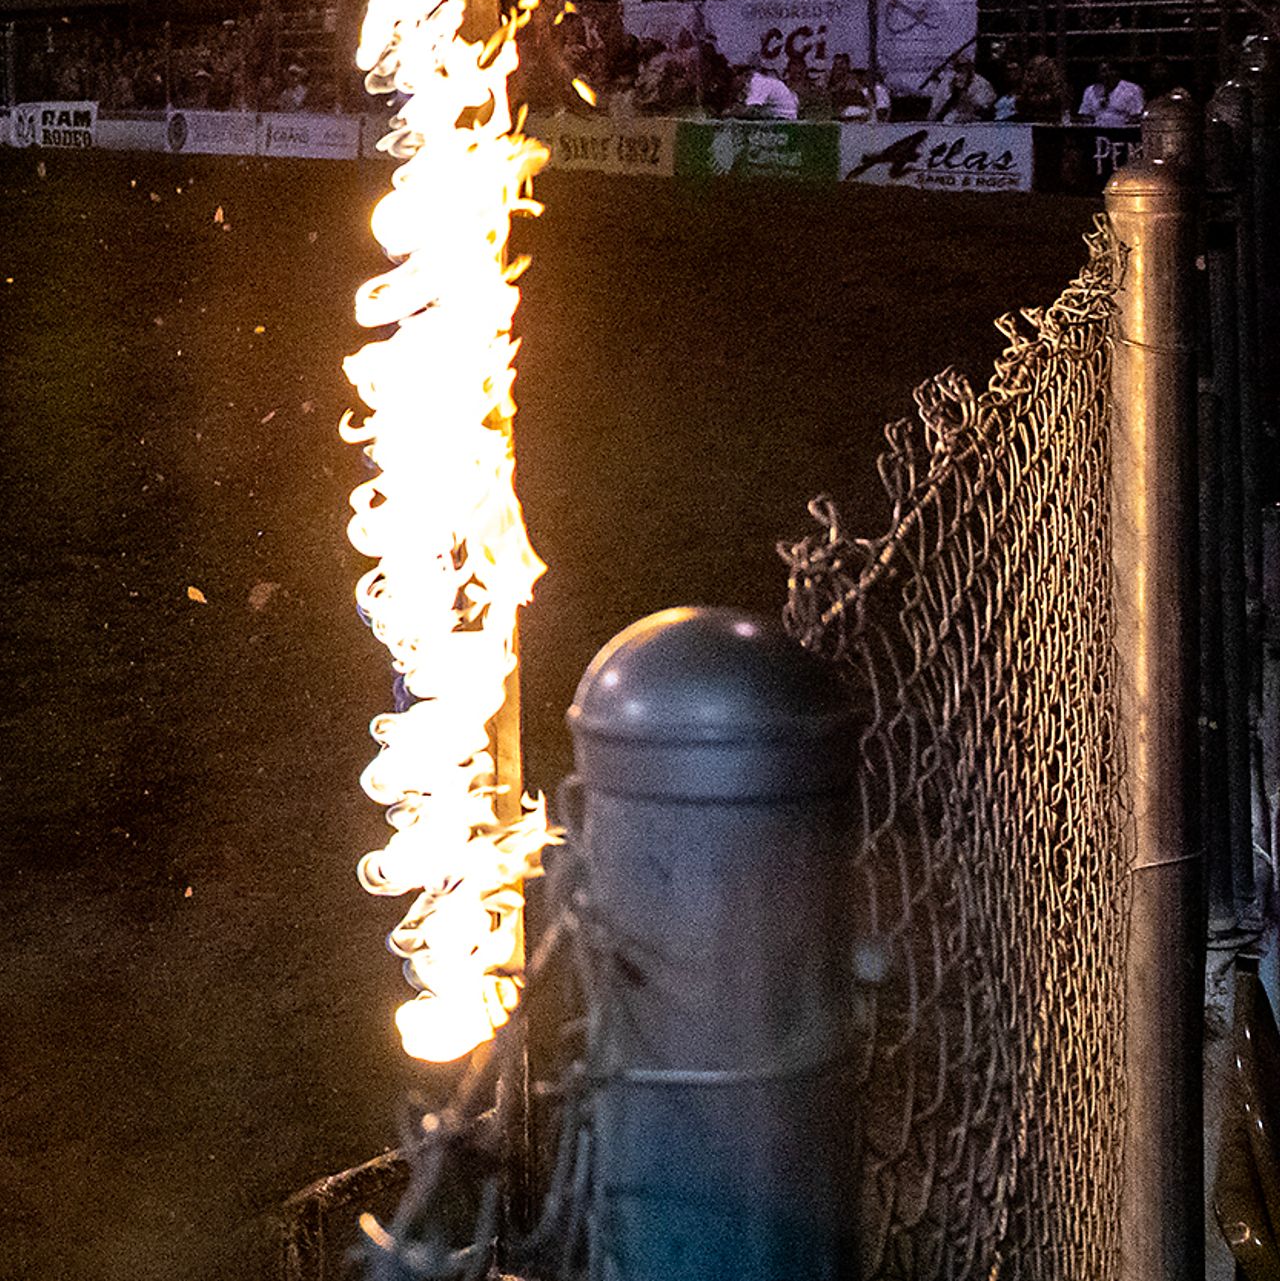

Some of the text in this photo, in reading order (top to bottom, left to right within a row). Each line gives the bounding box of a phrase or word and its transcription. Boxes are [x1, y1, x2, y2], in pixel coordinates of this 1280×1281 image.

[42, 110, 91, 127] RAM
[42, 128, 91, 147] RODEO
[845, 129, 1017, 180] Atlas
